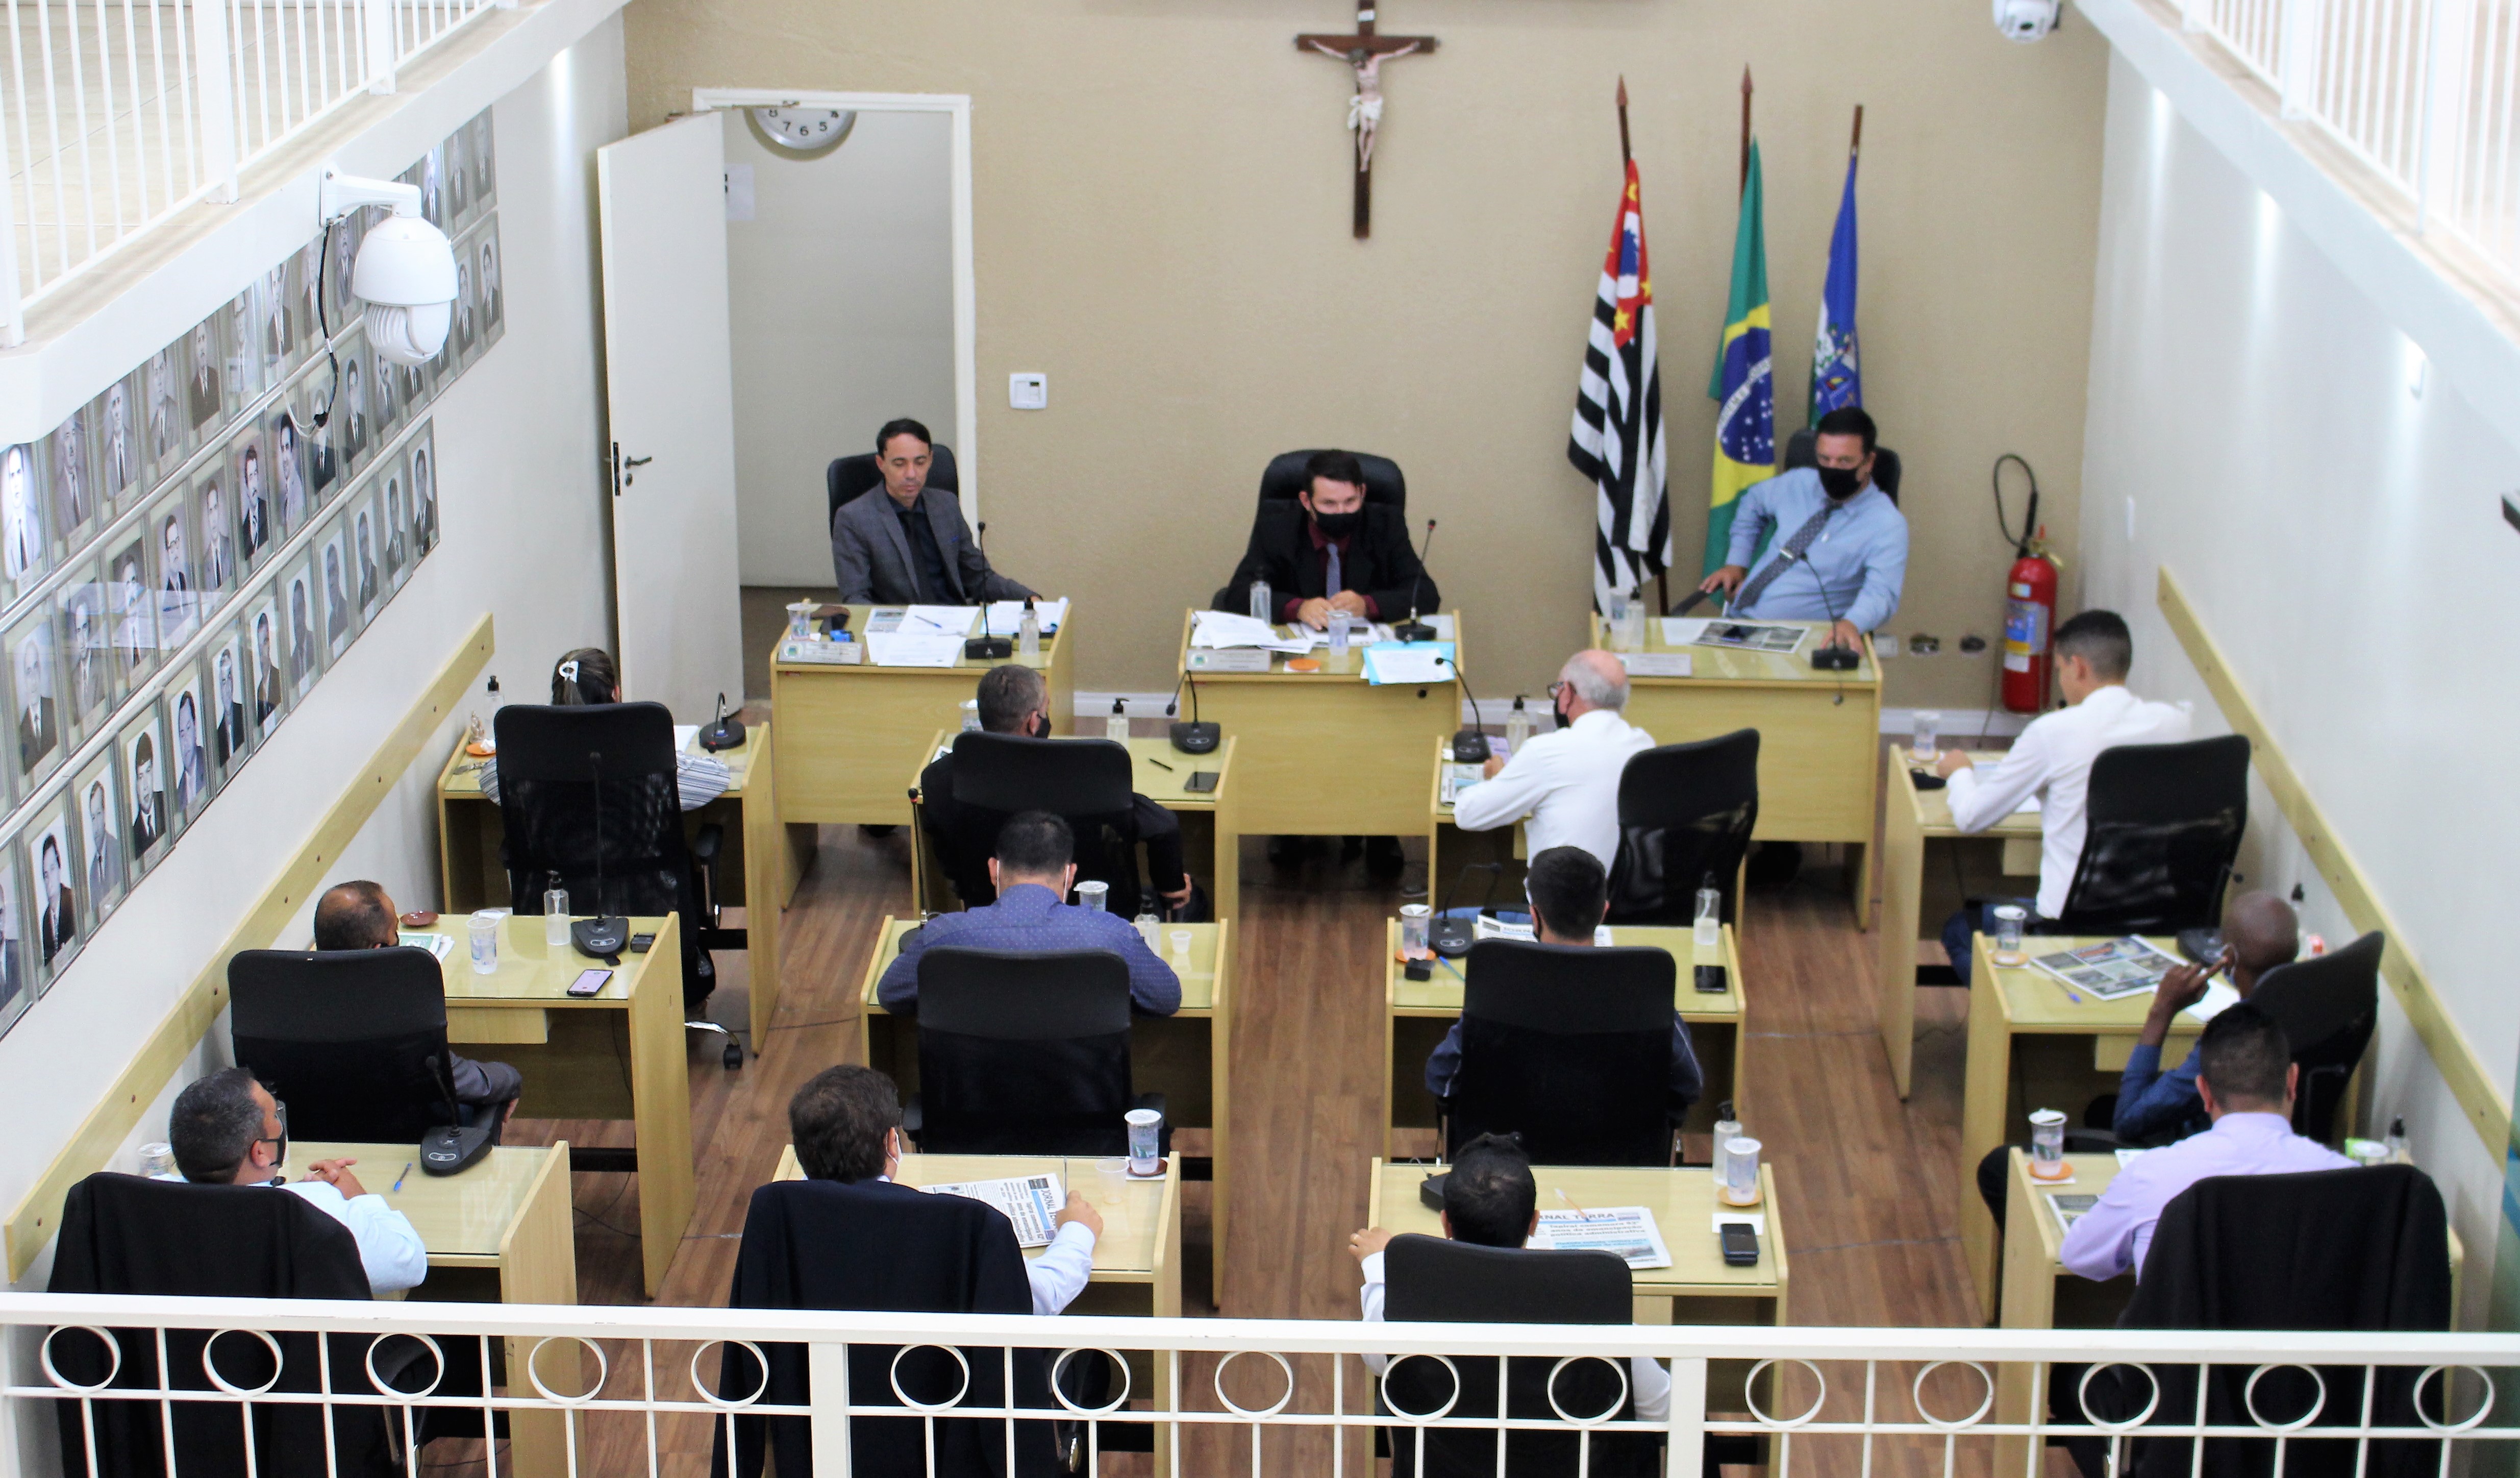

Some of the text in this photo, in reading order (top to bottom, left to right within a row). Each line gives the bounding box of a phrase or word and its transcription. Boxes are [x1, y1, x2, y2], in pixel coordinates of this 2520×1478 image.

[783, 121, 790, 131] 7
[800, 126, 808, 136] 6
[819, 121, 827, 131] 5
[1041, 1189, 1056, 1210] JORNAL
